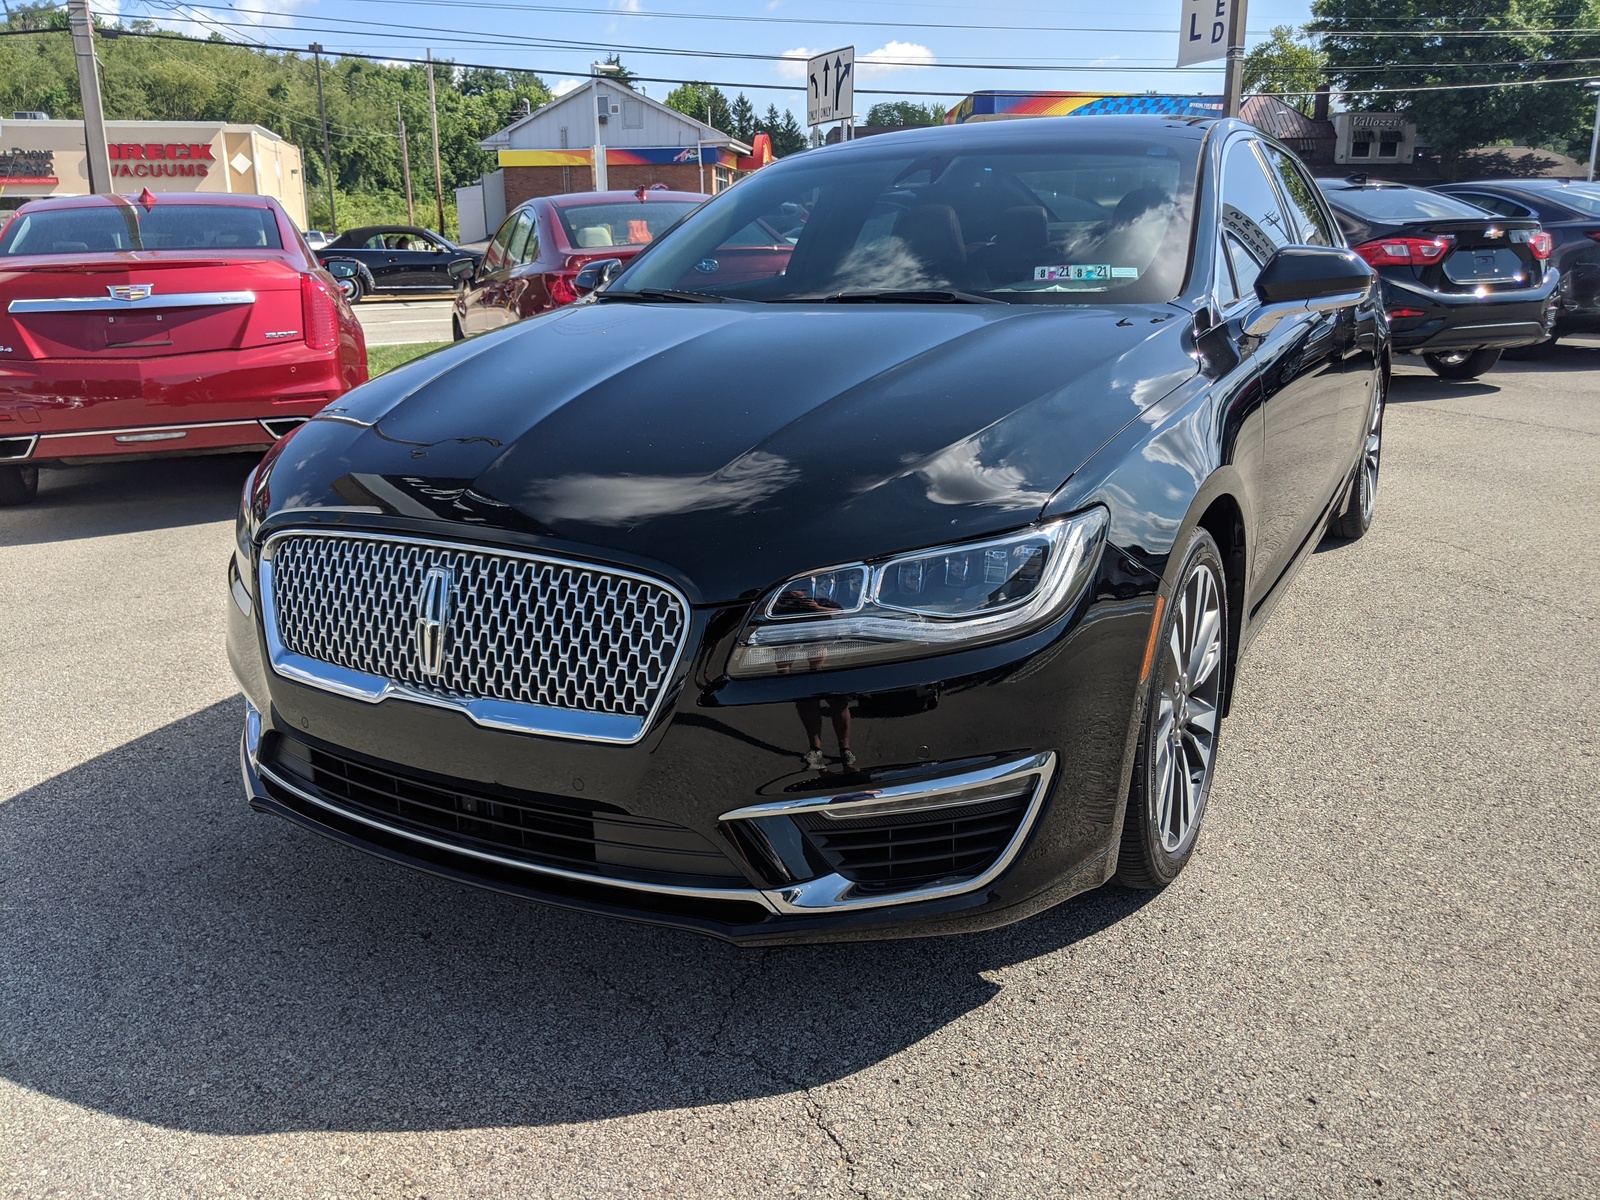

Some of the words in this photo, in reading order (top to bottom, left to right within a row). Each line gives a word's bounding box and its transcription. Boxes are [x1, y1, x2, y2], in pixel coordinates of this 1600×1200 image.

[808, 110, 818, 122] ONLY
[821, 106, 831, 119] ONLY
[1352, 116, 1404, 127] Vallozzi's
[111, 164, 209, 177] VACUUMS
[1040, 269, 1046, 278] 8
[1060, 266, 1070, 277] 21
[1077, 268, 1083, 278] 8
[1097, 265, 1108, 277] 21
